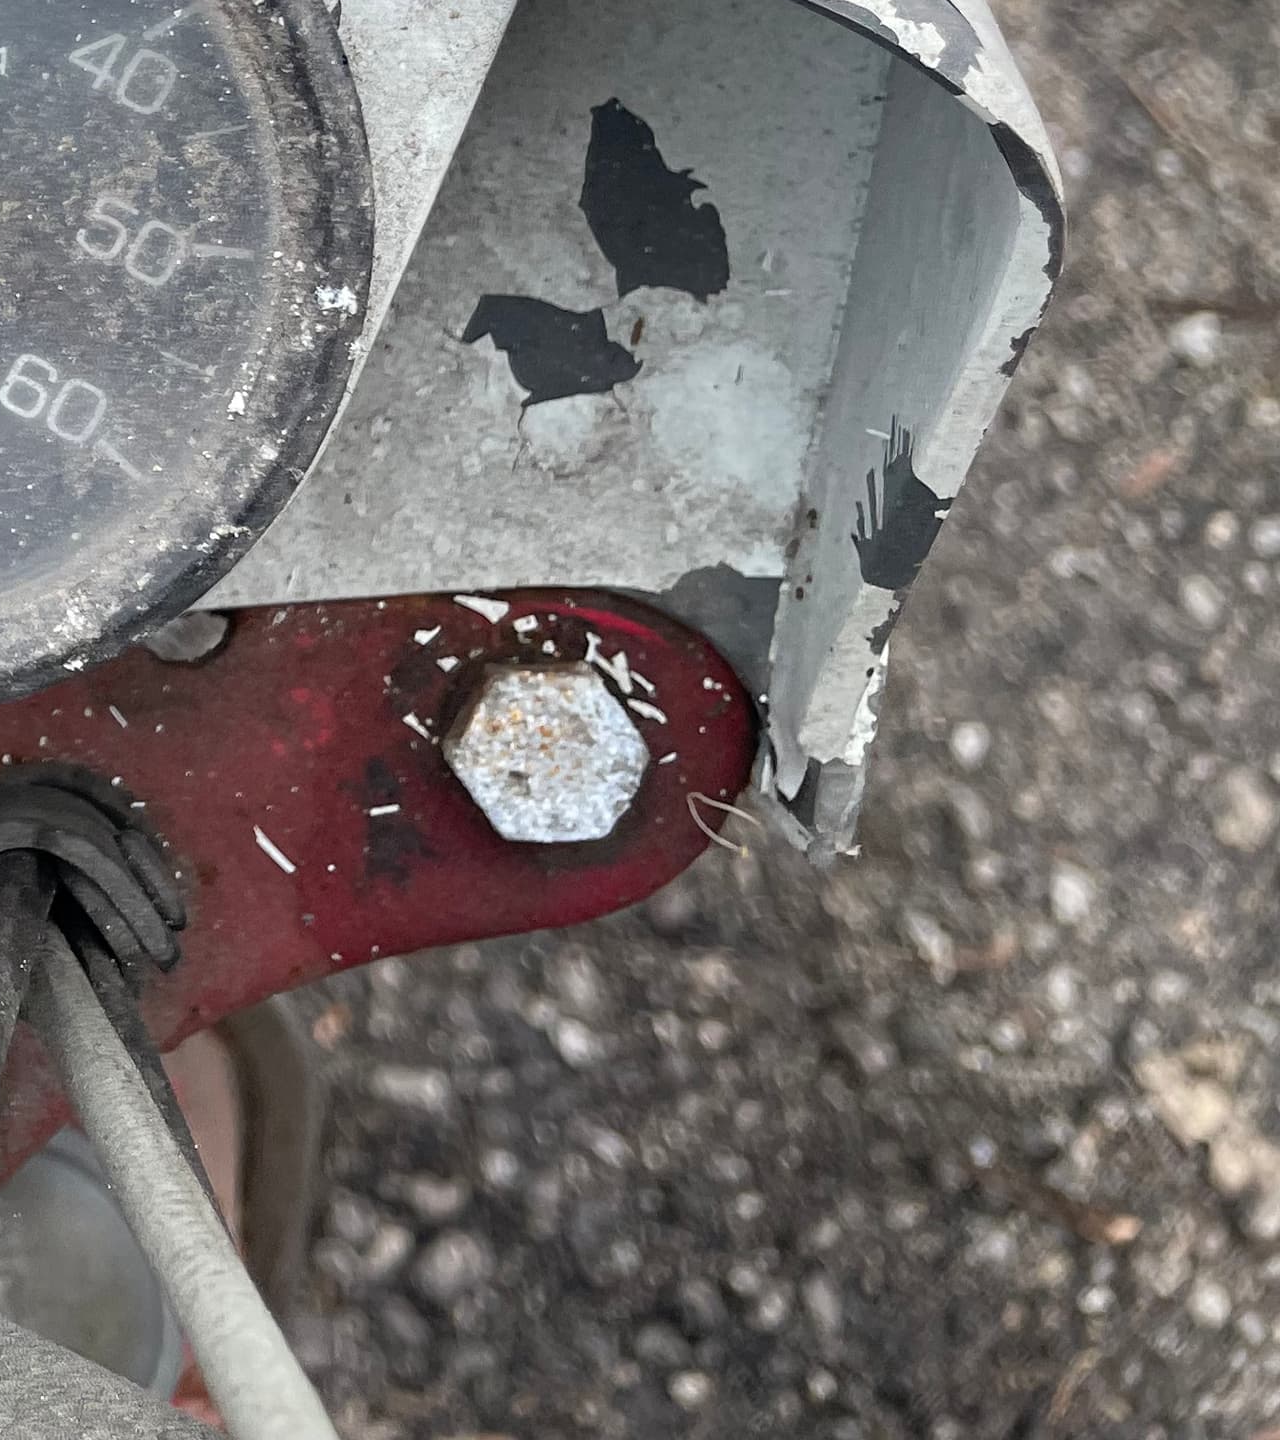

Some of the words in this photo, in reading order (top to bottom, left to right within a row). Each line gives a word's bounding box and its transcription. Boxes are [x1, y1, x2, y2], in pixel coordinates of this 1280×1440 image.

[69, 33, 178, 114] 40
[76, 195, 185, 287] 50
[0, 353, 107, 442] 60
